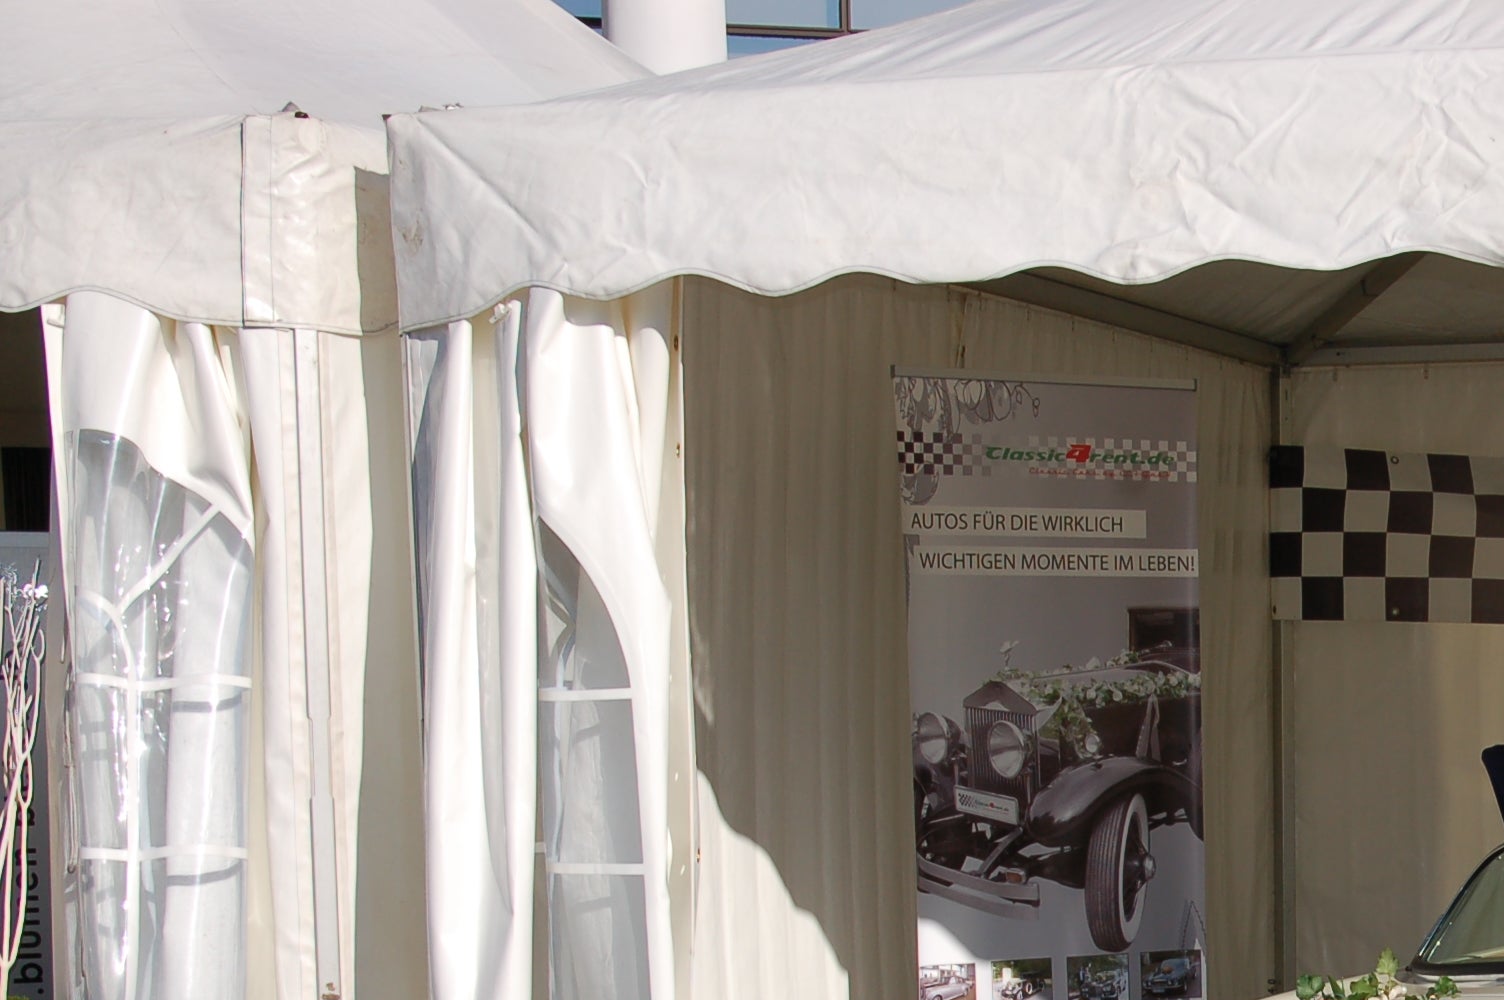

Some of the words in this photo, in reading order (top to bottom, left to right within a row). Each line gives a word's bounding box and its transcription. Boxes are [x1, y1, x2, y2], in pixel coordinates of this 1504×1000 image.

[985, 444, 1175, 466] Classic4rent.de
[911, 512, 968, 530] AUTOS
[973, 510, 1005, 531] FÜR
[1011, 514, 1038, 531] DIE
[1041, 514, 1123, 533] WIRKLICH
[919, 552, 1016, 570] WICHTIGEN
[1021, 553, 1109, 571] MOMENTE
[1114, 554, 1133, 571] IM
[1138, 555, 1195, 572] LEBEN!
